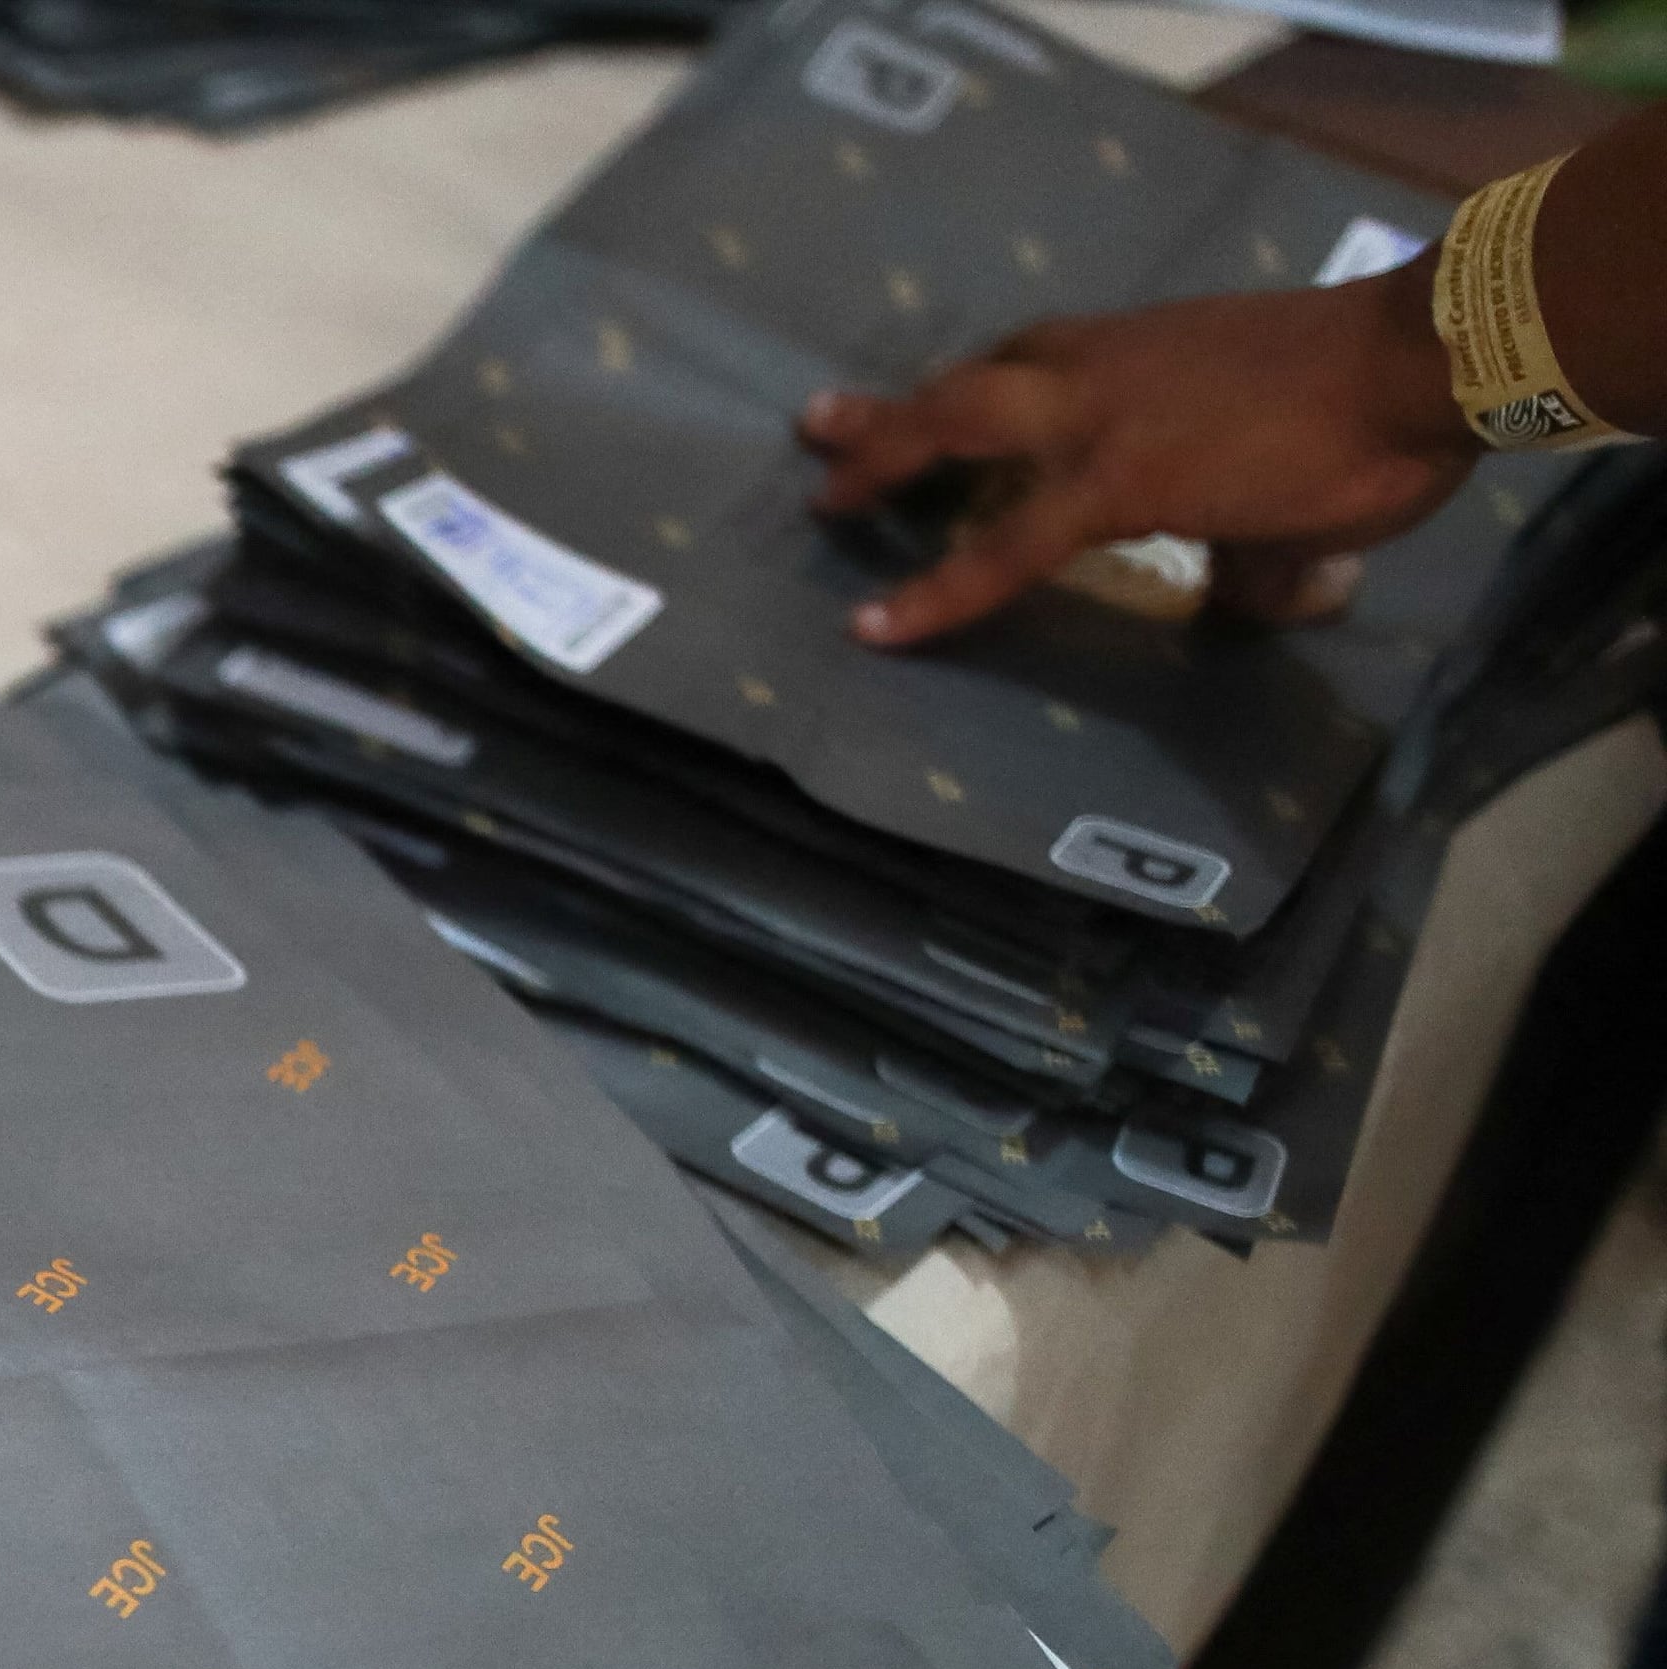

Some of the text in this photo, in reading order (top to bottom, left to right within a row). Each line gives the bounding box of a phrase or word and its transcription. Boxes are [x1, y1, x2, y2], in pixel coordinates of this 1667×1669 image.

[1448, 249, 1466, 326] Central
[1458, 329, 1484, 389] Junta
[15, 884, 166, 965] D
[14, 1256, 90, 1315] JCE
[387, 1232, 459, 1293] JCE
[87, 1538, 167, 1619] JCE
[500, 1513, 575, 1593] JCE
